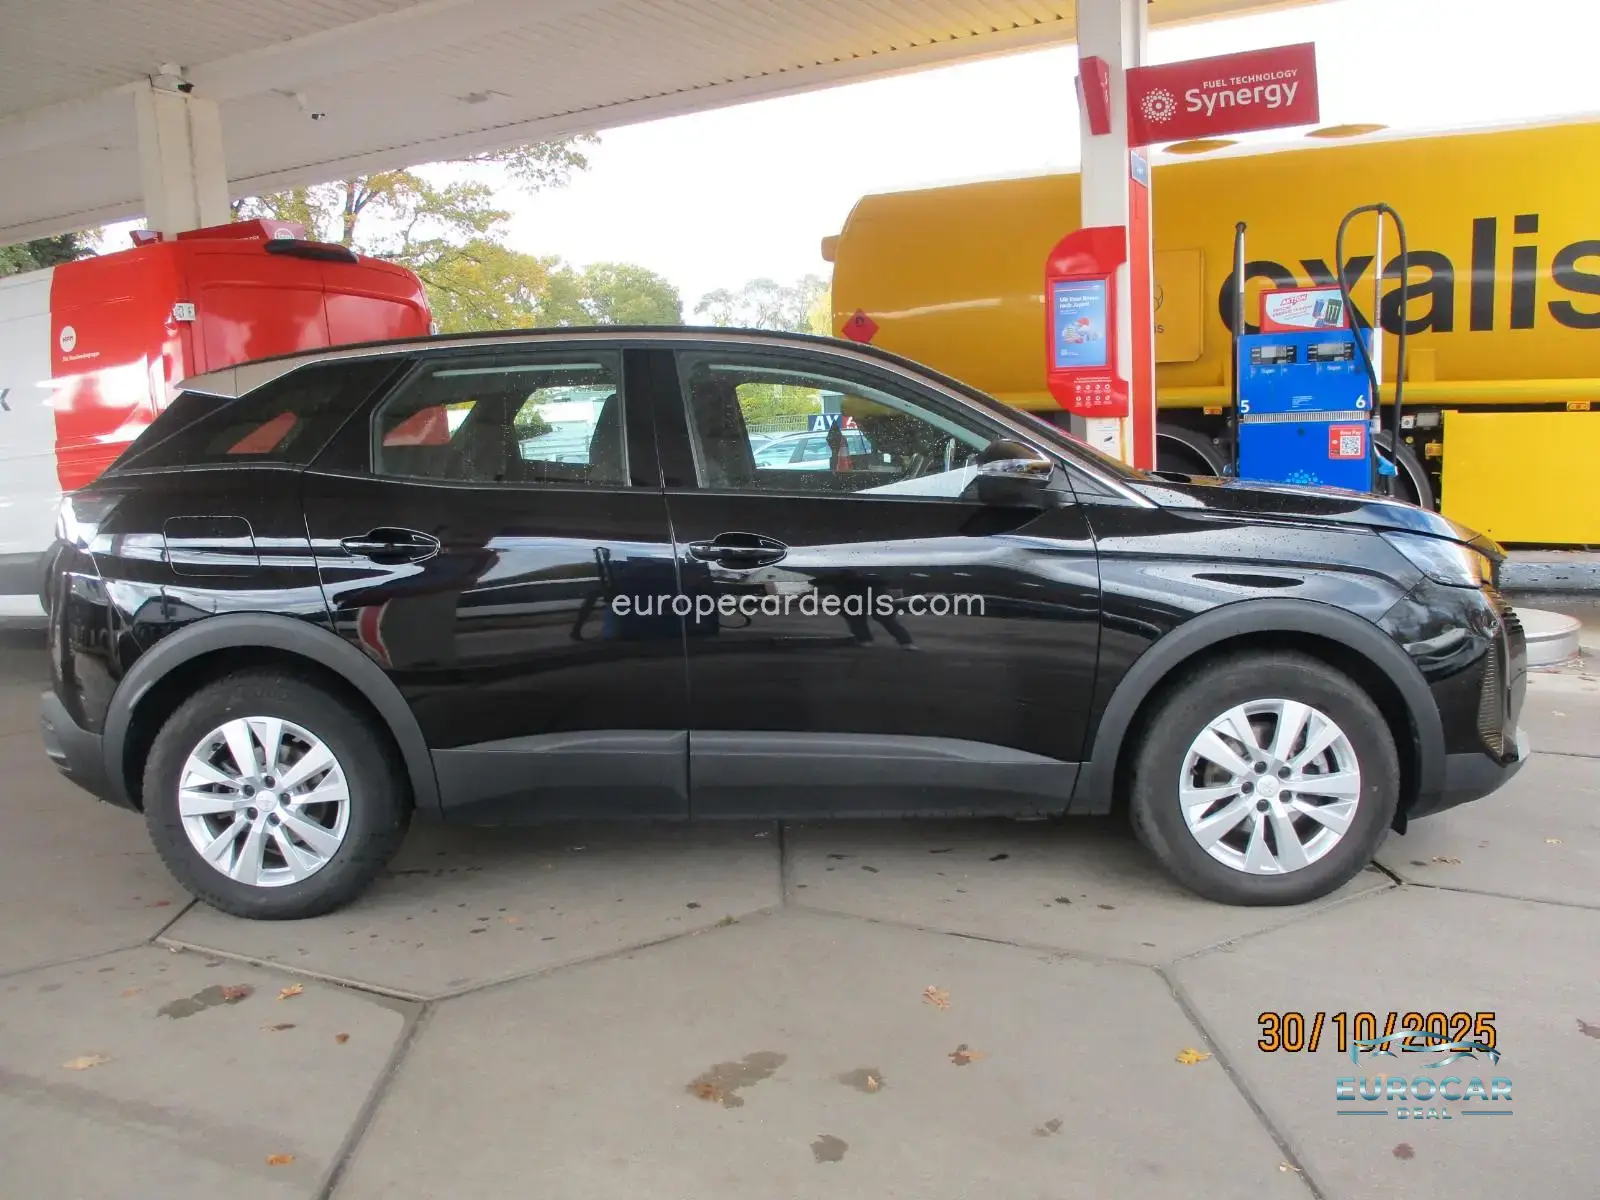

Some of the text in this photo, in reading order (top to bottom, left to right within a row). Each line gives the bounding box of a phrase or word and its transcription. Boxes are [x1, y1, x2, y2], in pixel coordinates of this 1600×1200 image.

[1202, 69, 1298, 89] FUEL TECHNOLOGY
[1185, 81, 1298, 117] Synergy
[1218, 213, 1600, 337] oxalis
[1240, 399, 1251, 414] 5
[1355, 394, 1366, 409] 6
